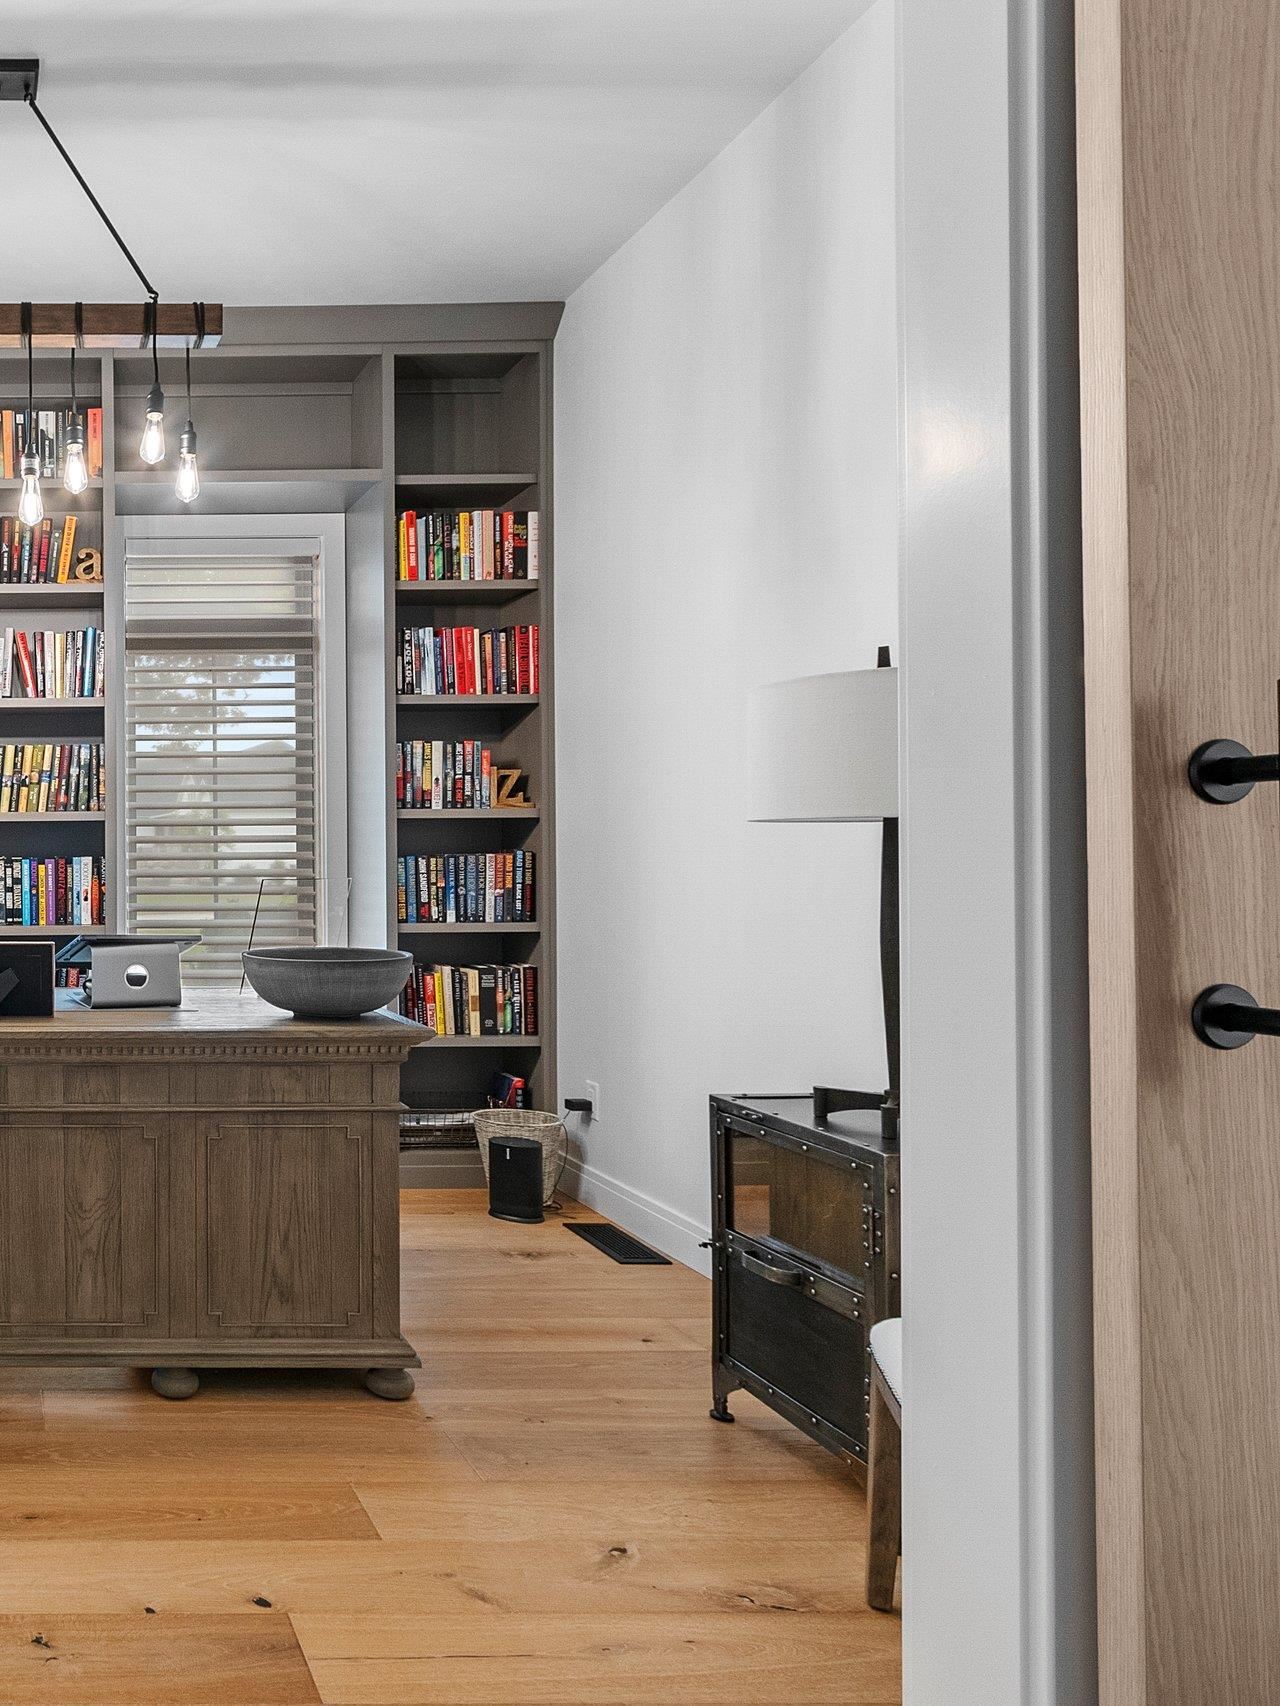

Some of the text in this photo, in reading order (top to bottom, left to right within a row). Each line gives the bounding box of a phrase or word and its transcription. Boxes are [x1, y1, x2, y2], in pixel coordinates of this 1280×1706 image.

[76, 547, 102, 580] a
[404, 630, 411, 640] IQ
[464, 775, 472, 796] MURDER
[496, 769, 524, 804] Z
[468, 855, 476, 890] BRAD THOR
[525, 852, 533, 868] BRAD
[418, 858, 429, 903] JOHN SANDFORD
[505, 872, 513, 888] THOR
